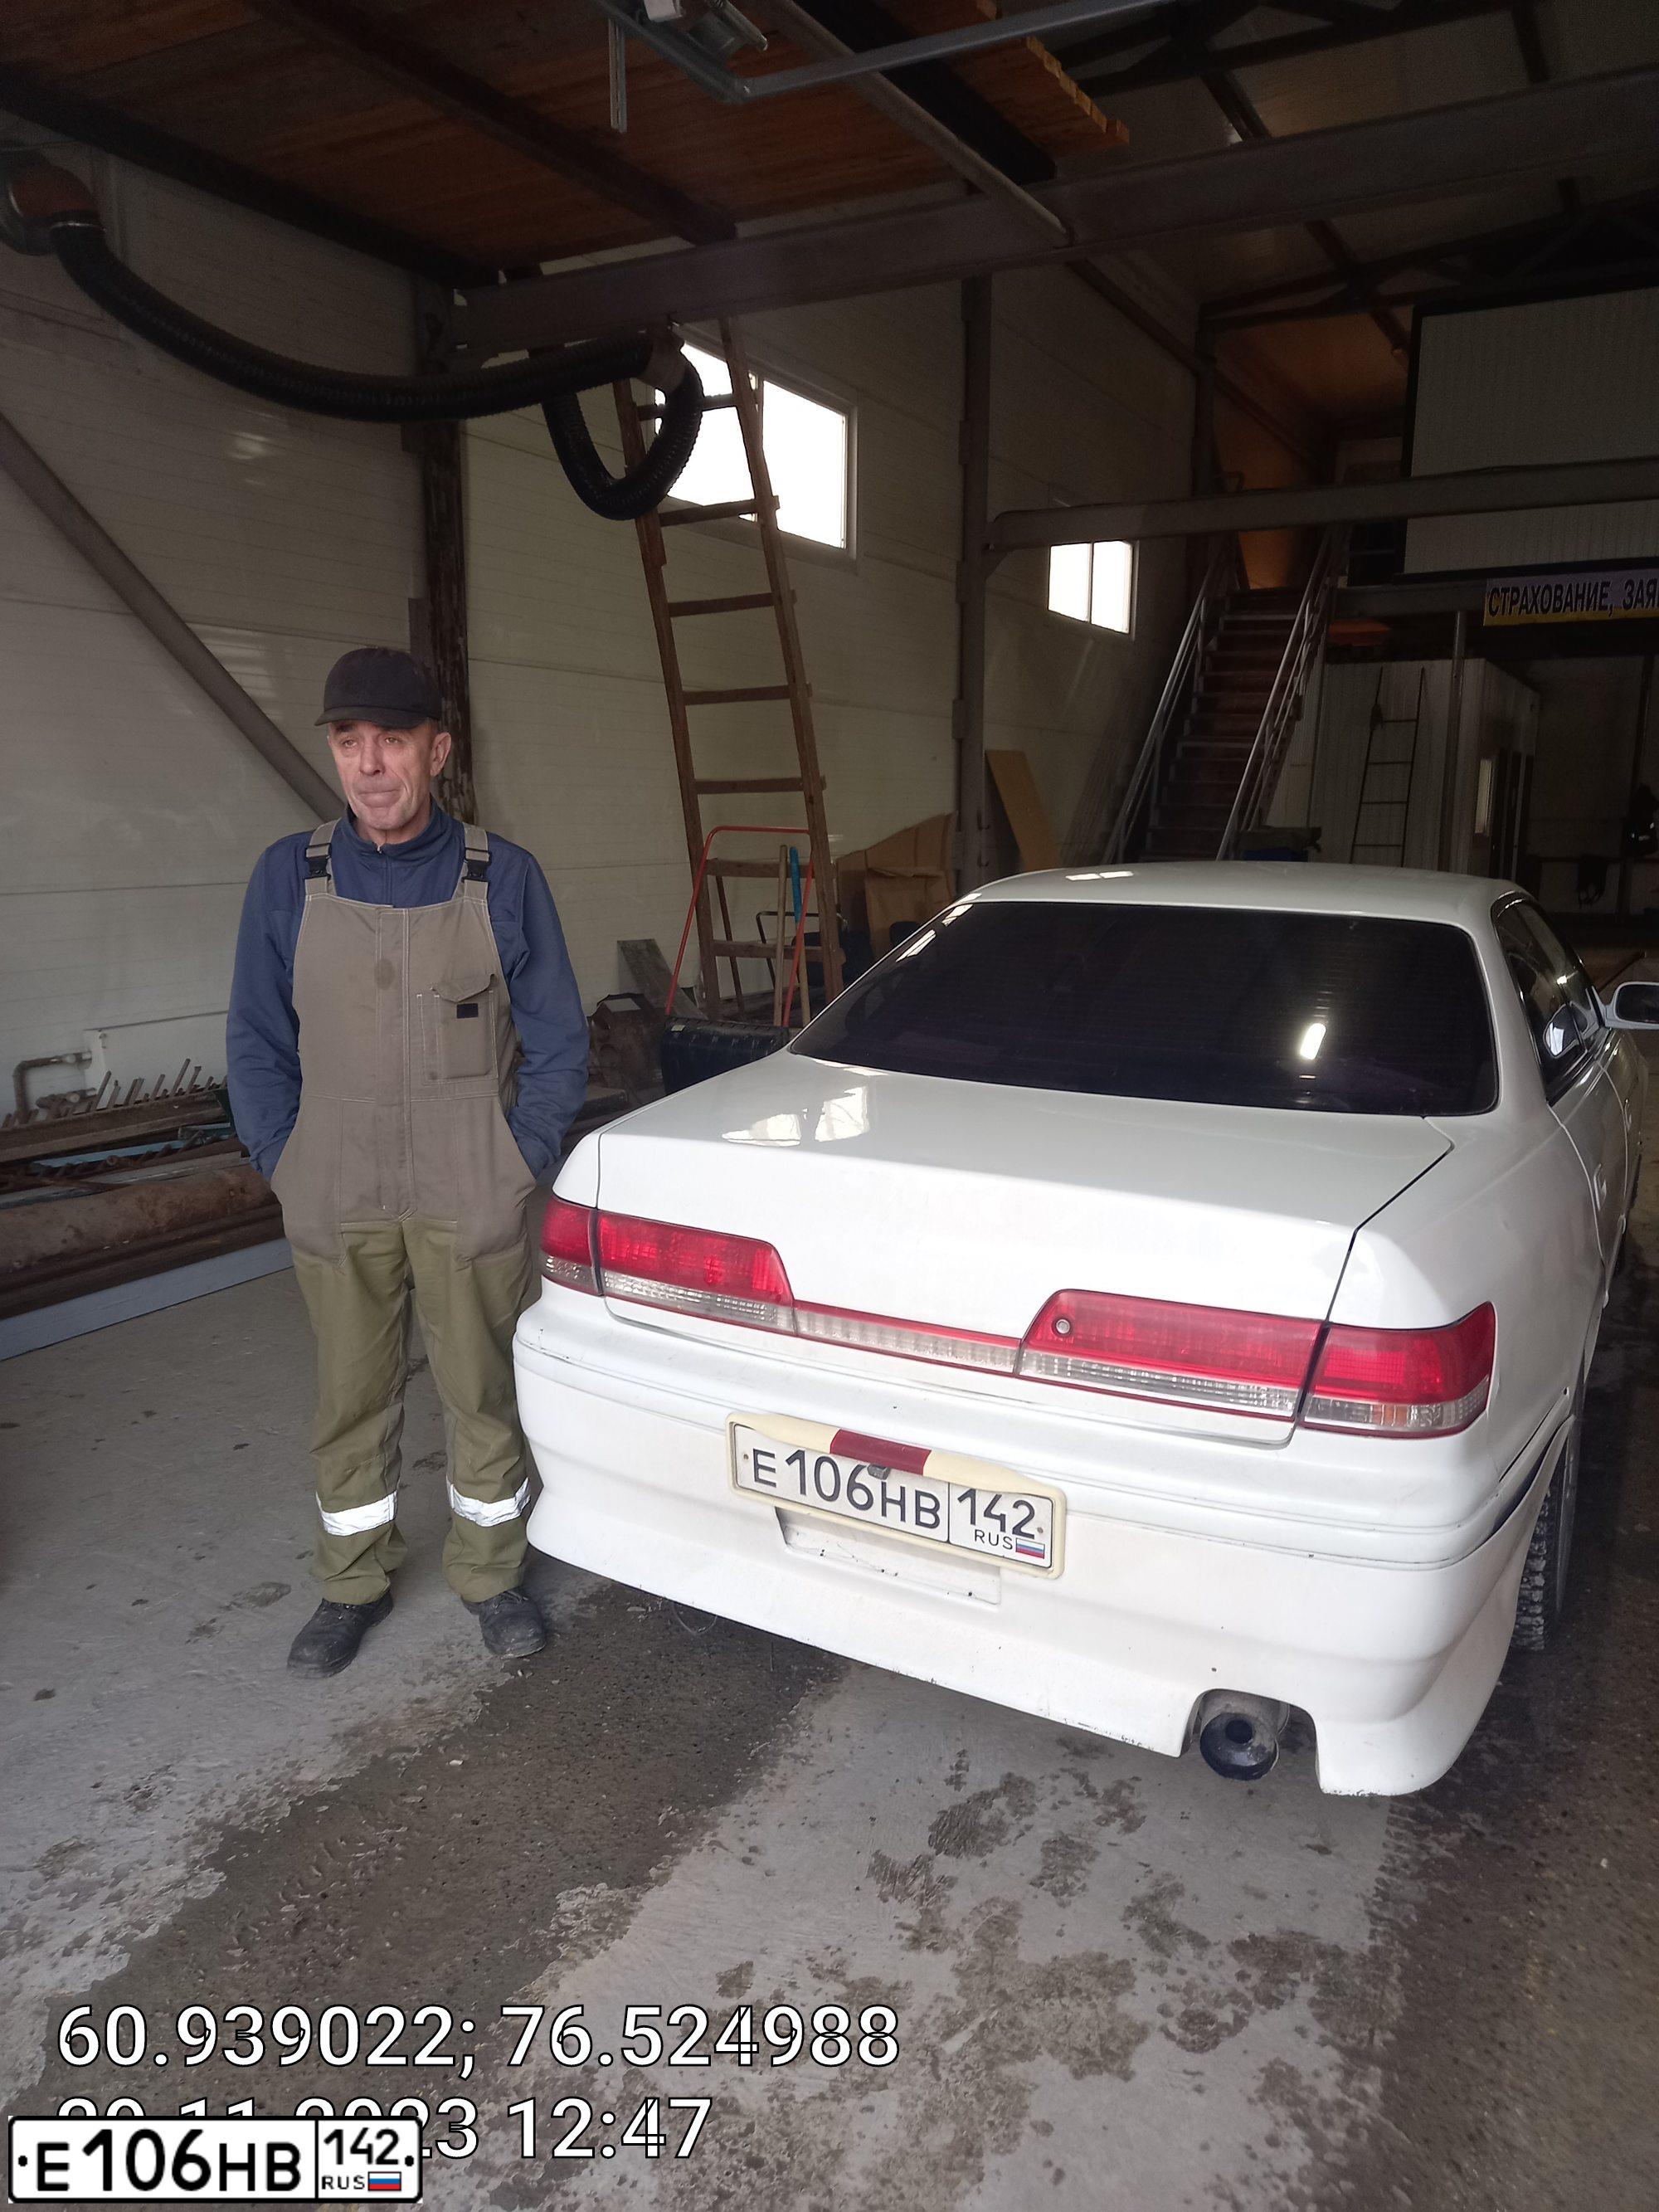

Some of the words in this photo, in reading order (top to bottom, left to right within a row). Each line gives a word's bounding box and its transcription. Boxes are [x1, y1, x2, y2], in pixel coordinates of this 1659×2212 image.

[1488, 582, 1614, 617] СТРАХОВАНИЕ,
[1622, 578, 1659, 611] ЗАЯ
[956, 1488, 1036, 1540] 142
[974, 1528, 1014, 1551] RUS
